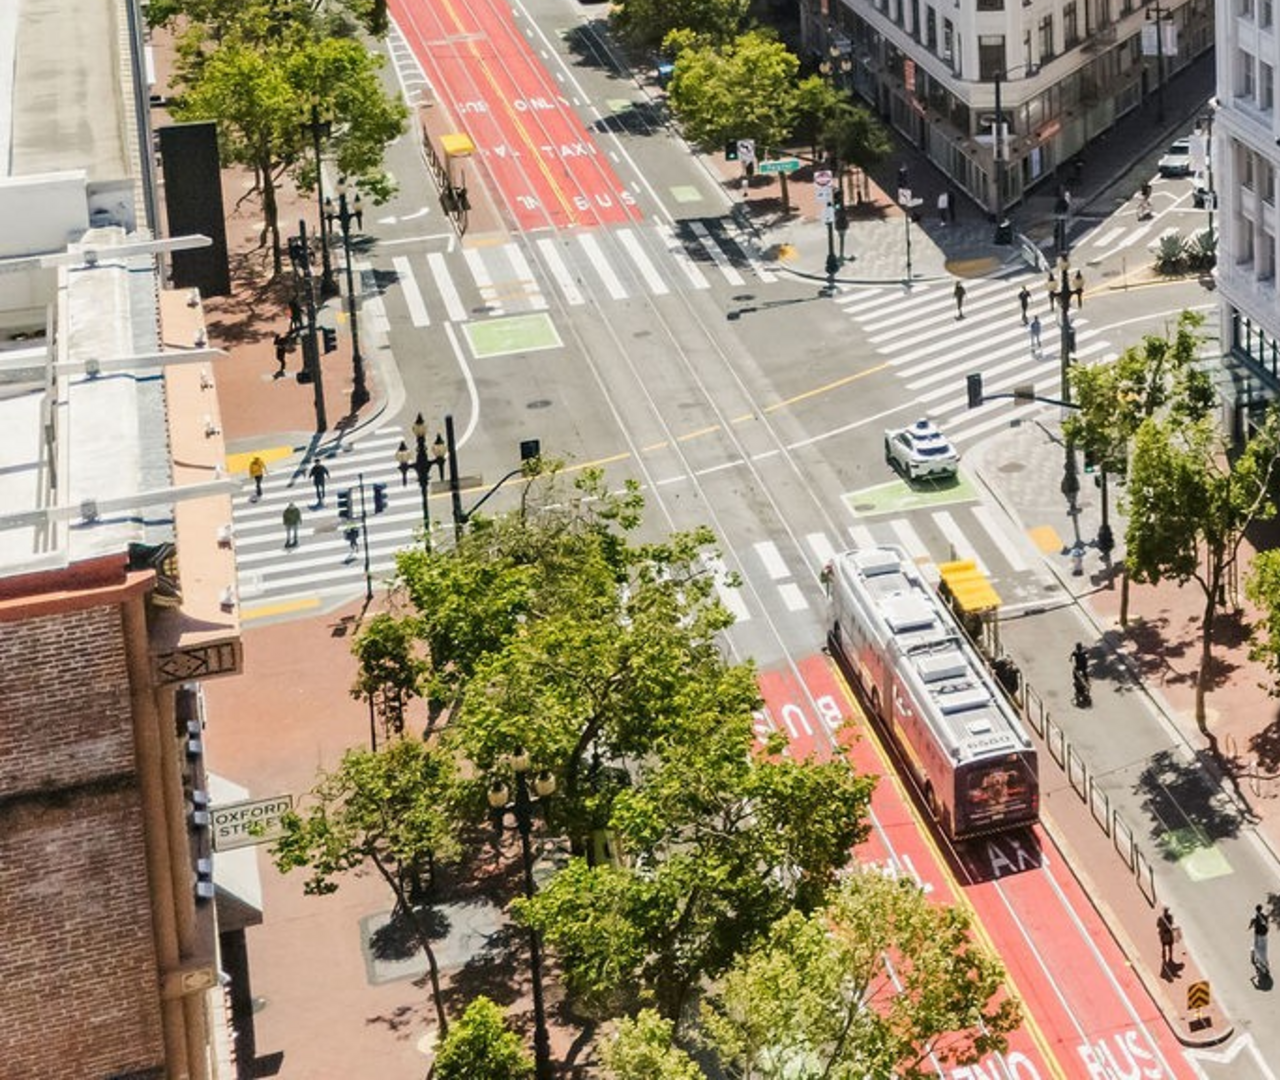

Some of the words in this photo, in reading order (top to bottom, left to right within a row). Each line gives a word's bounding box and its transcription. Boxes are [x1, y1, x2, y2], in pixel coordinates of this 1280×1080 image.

[540, 141, 597, 158] TAXI
[573, 189, 637, 211] BUS
[215, 801, 289, 825] OXFORD
[1076, 1031, 1164, 1080] BUS
